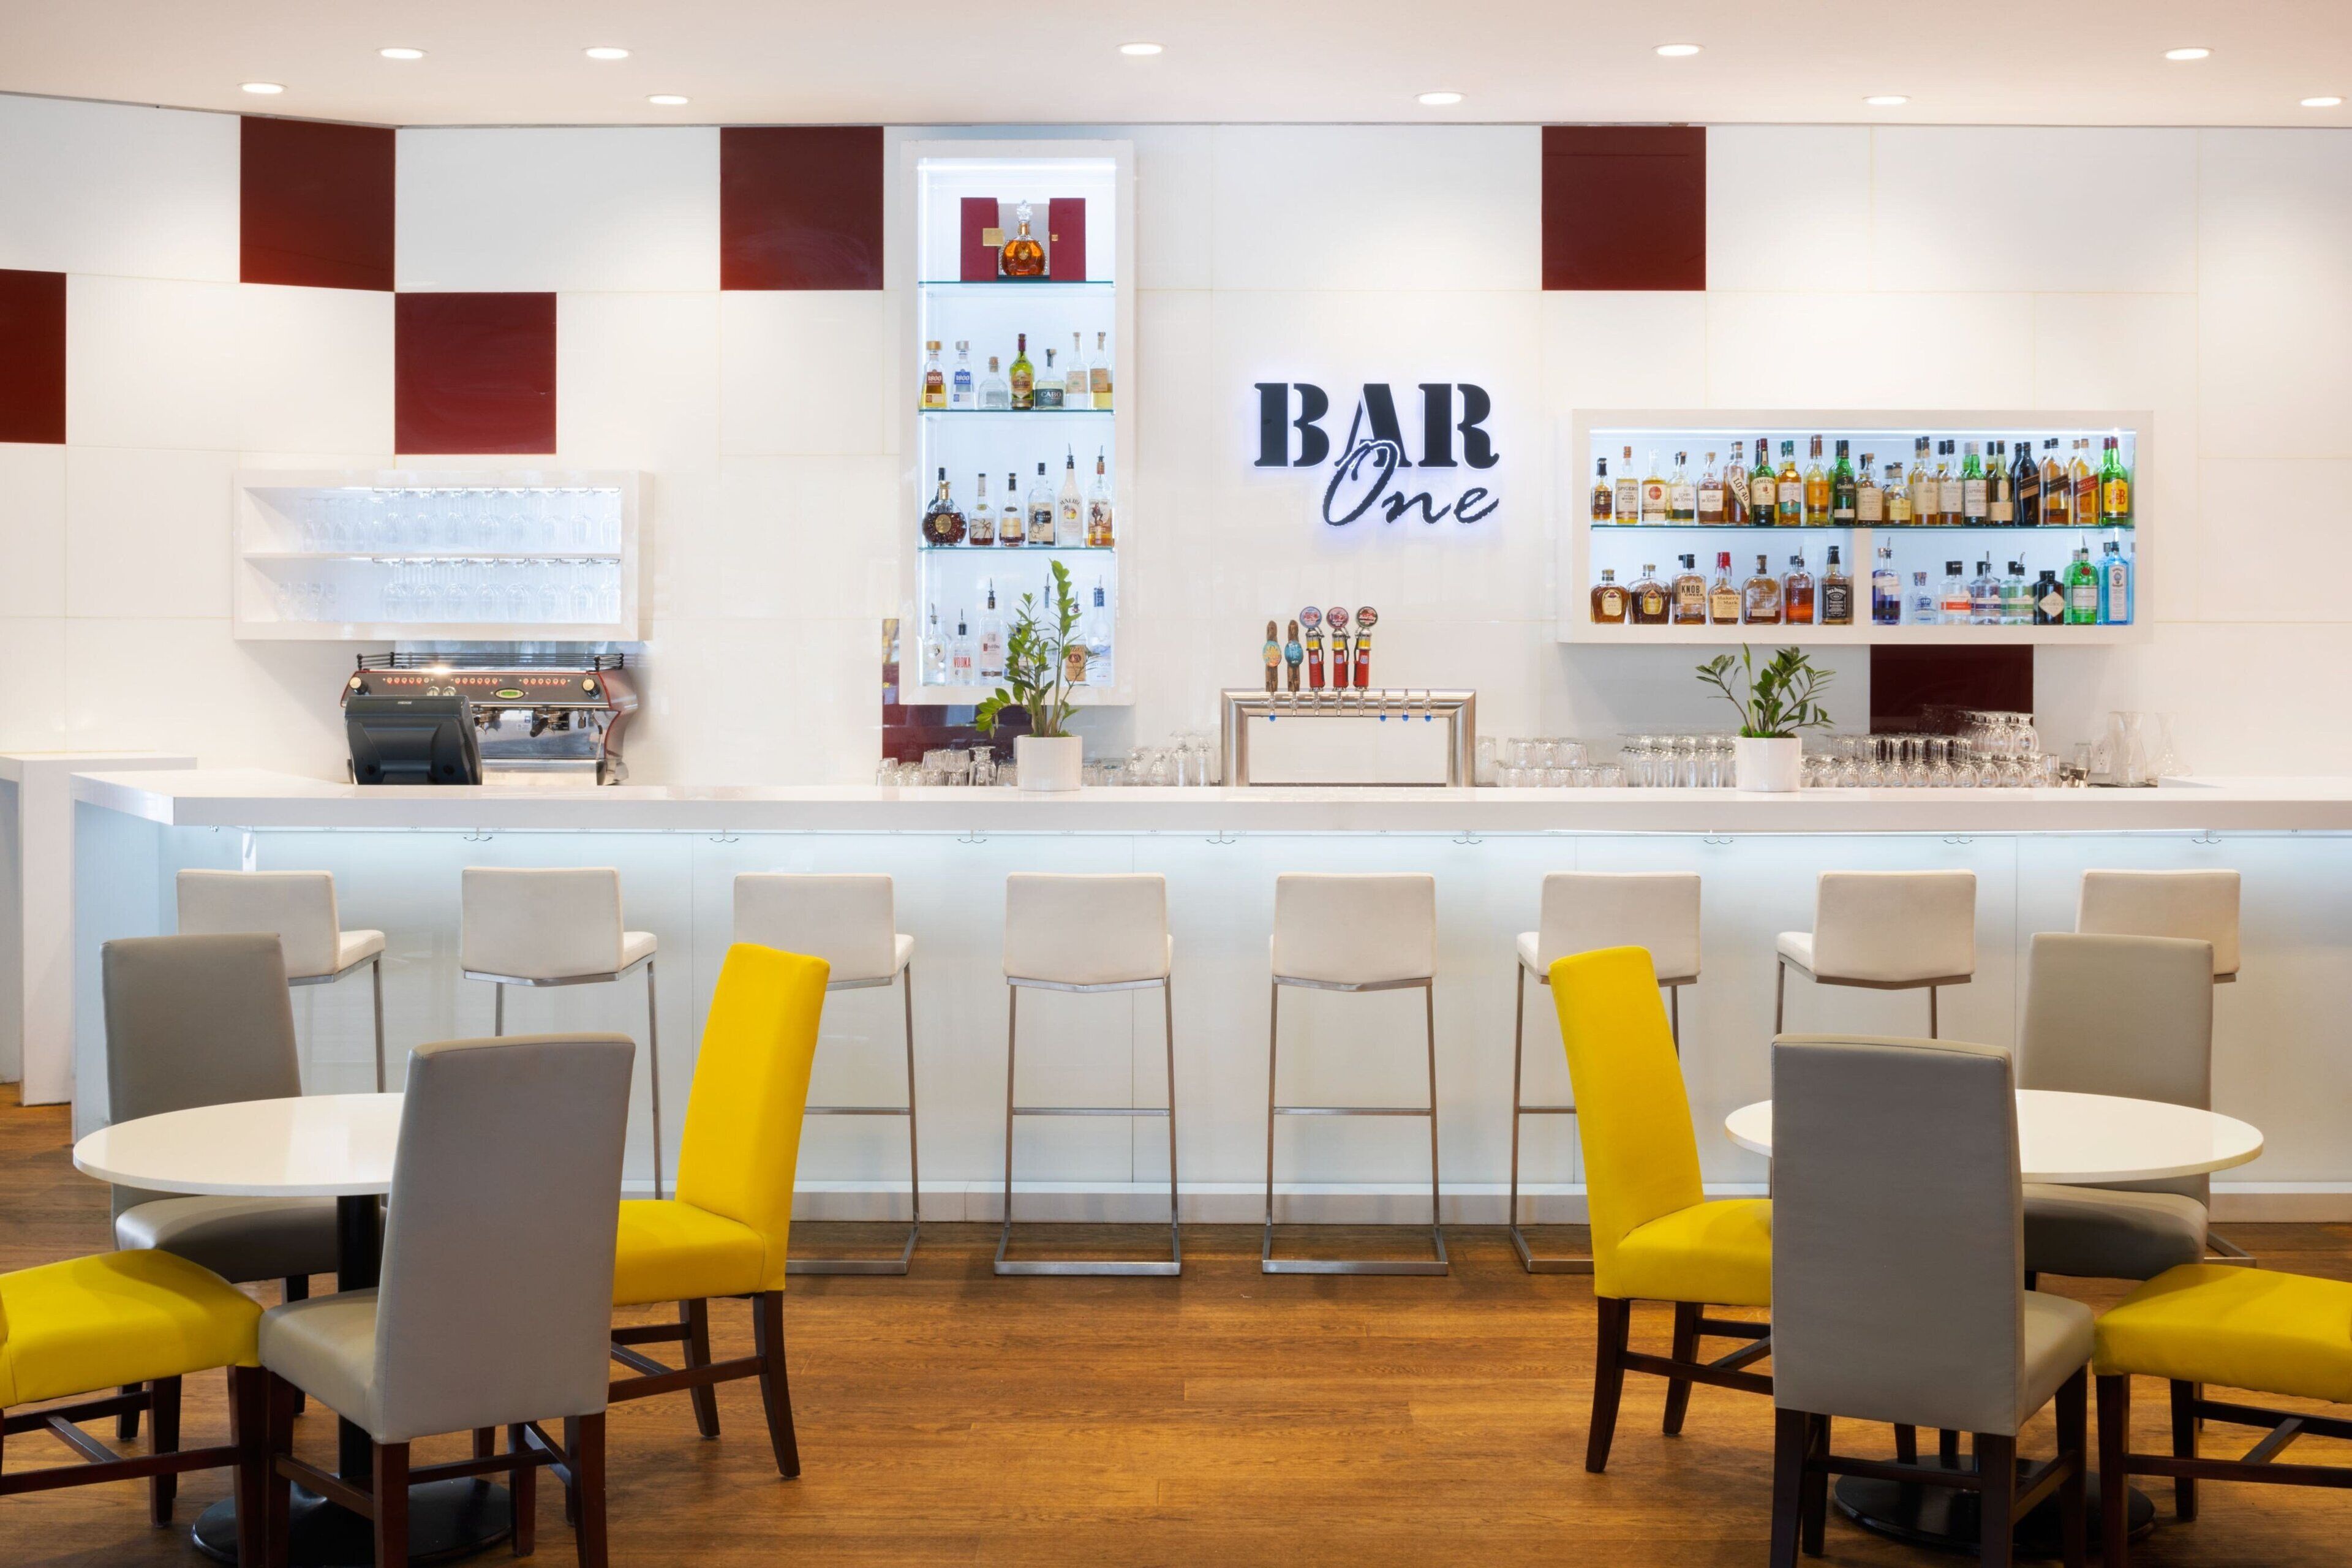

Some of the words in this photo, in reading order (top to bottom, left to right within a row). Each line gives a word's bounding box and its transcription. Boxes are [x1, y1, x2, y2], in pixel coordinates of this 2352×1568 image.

[1254, 383, 1500, 469] BAR
[1322, 440, 1499, 527] One
[1733, 478, 1744, 492] LOT
[1741, 492, 1750, 502] 40
[1681, 585, 1700, 594] KNOB
[953, 657, 971, 668] VODKA
